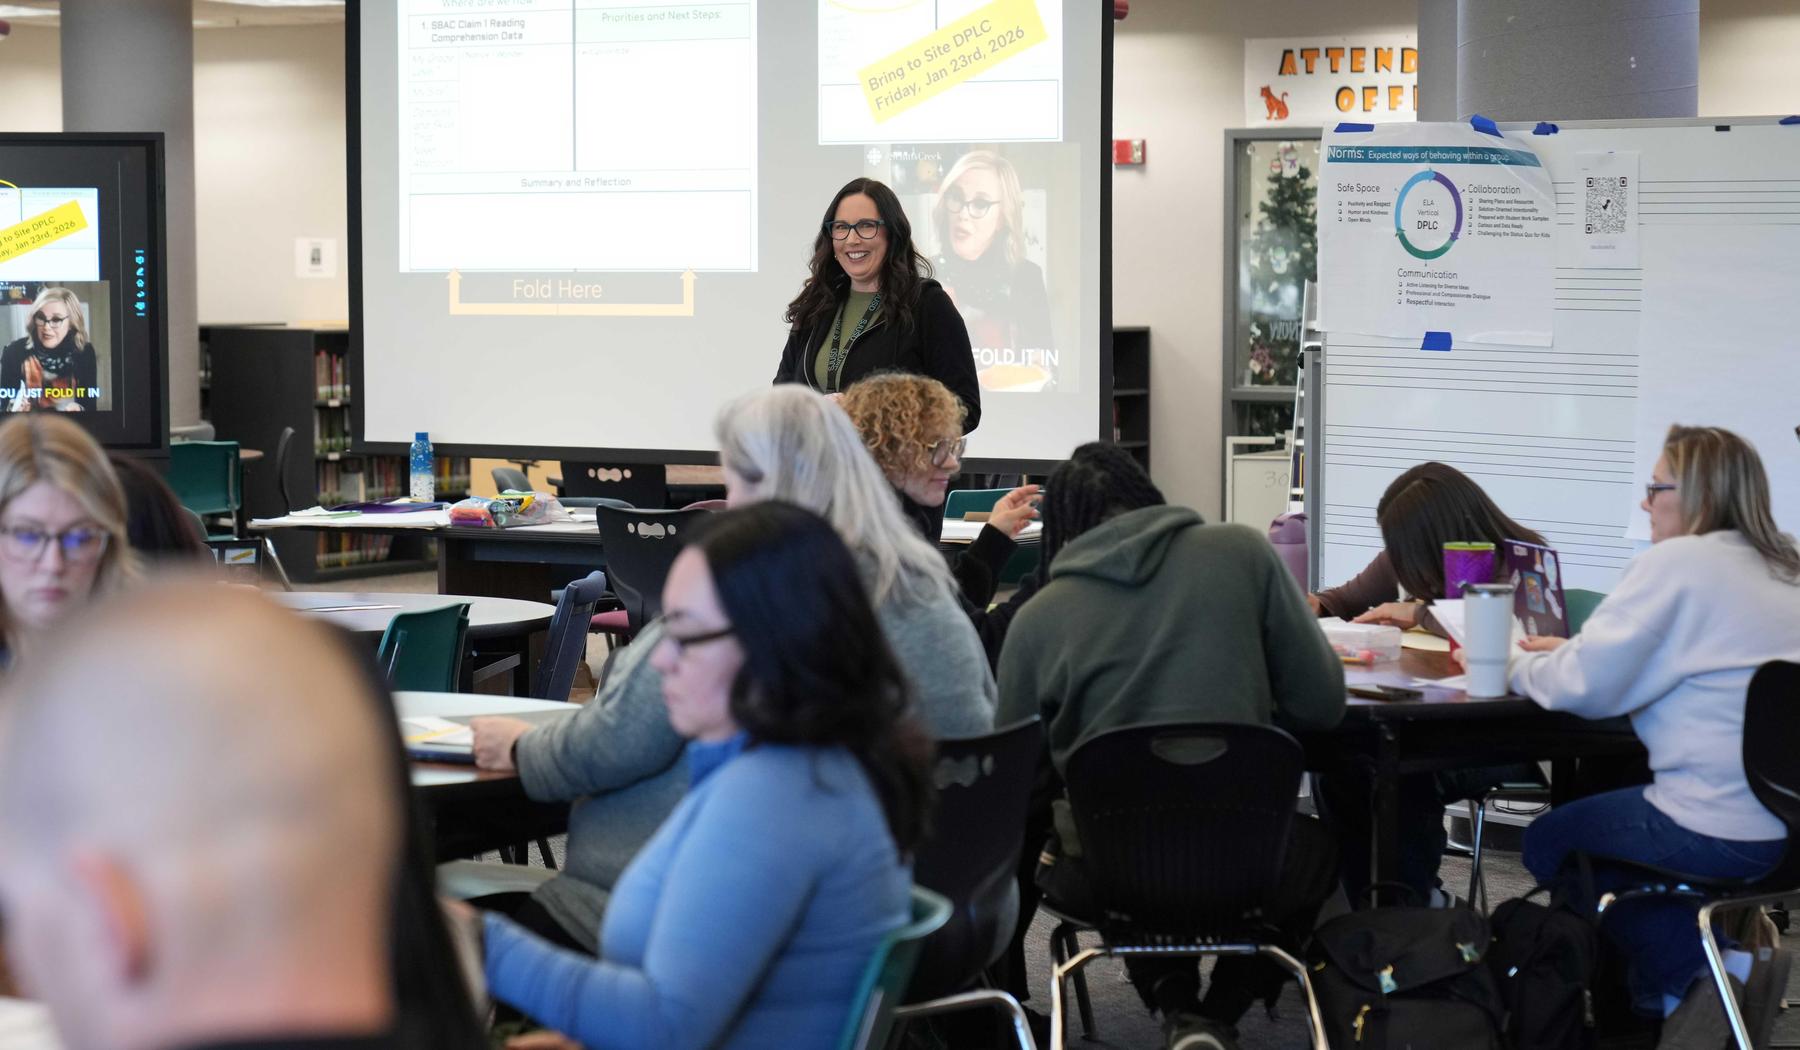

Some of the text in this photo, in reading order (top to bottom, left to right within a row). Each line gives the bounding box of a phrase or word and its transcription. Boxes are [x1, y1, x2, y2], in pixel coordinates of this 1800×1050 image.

[601, 11, 645, 22] Priorities
[647, 11, 666, 21] and
[668, 10, 690, 20] Next
[431, 20, 456, 30] SBAC
[458, 19, 482, 29] Claim
[490, 18, 526, 29] Reading
[431, 31, 524, 43] Comprehension Data
[867, 19, 992, 91] Bring to Site DPLC
[875, 26, 1025, 111] Friday, Jan 23rd, 2026
[1328, 147, 1365, 159] Norms:
[1368, 150, 1401, 160] Expected
[1402, 152, 1420, 161] ways
[1420, 151, 1428, 159] of
[1429, 151, 1462, 161] behaving
[1463, 151, 1483, 160] within
[521, 177, 632, 188] Summary and Reflection
[1337, 182, 1380, 194] Safe Space
[1468, 183, 1521, 194] Collaboration
[1374, 200, 1391, 208] Respect
[4, 235, 13, 244] to
[14, 227, 31, 239] Site
[31, 215, 56, 231] DPLC
[1417, 220, 1438, 230] DPLC
[15, 239, 30, 251] Jan
[30, 231, 53, 244] 23rd,
[53, 220, 76, 234] 2026
[1397, 267, 1458, 279] Communication
[512, 279, 602, 299] Fold Here
[1406, 297, 1433, 306] Respectful
[1021, 348, 1035, 367] IT
[1040, 348, 1059, 367] IN
[44, 387, 74, 399] FOLD
[76, 387, 86, 398] IT
[88, 387, 100, 399] IN
